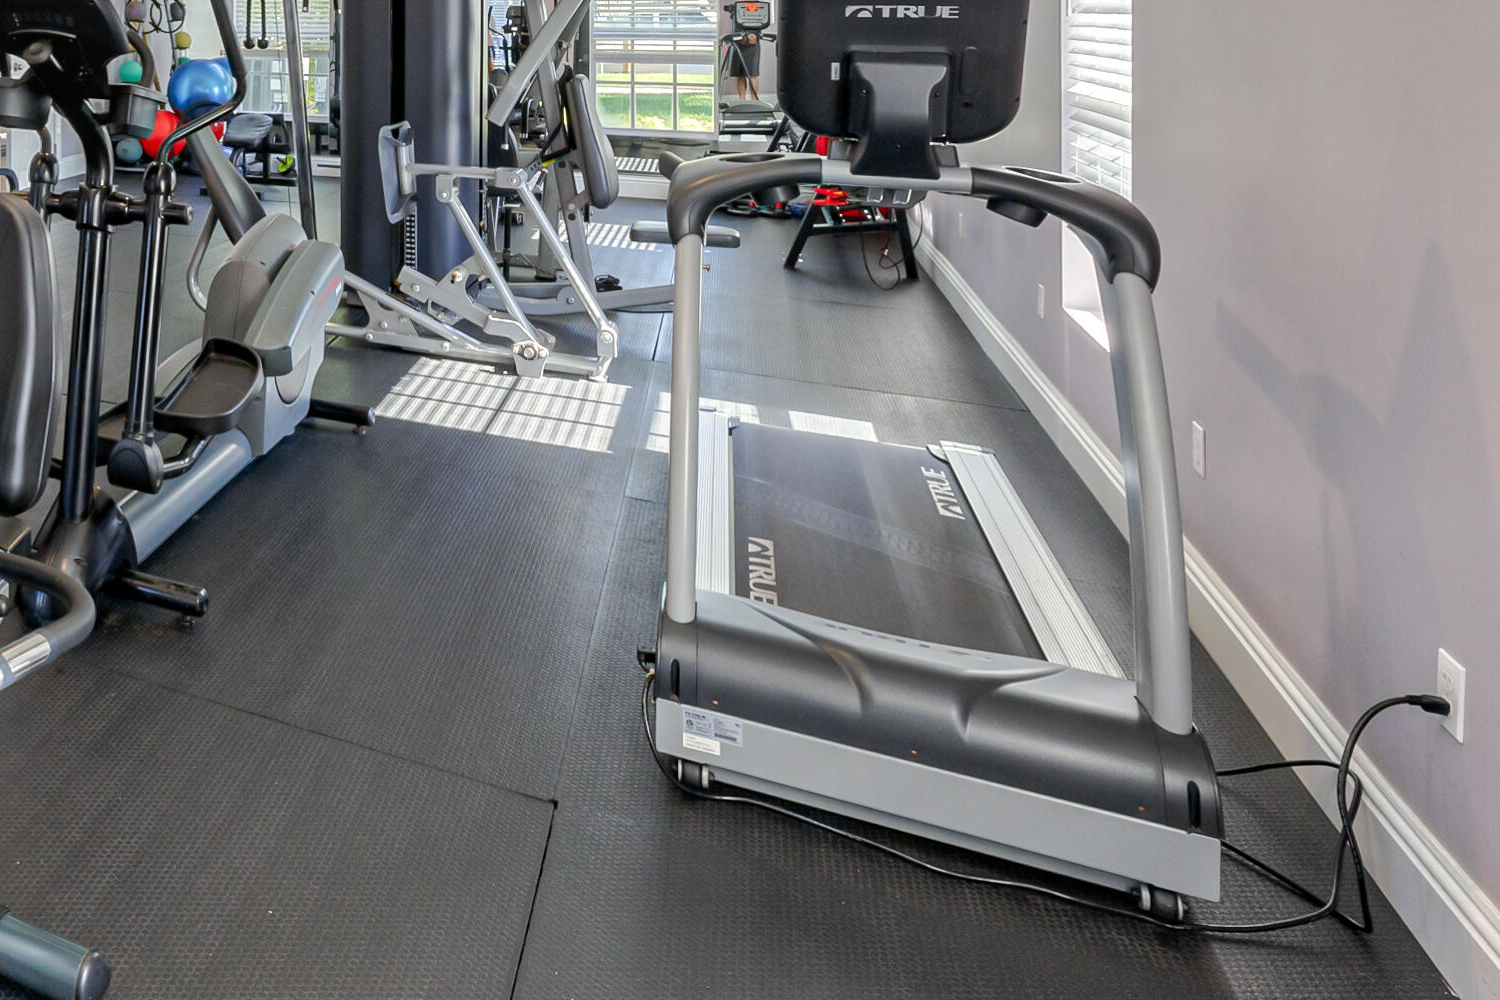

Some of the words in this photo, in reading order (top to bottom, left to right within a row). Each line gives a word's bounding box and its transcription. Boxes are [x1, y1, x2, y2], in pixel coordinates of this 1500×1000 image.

[875, 5, 960, 19] TRUE
[921, 466, 960, 507] TRUE
[748, 555, 778, 606] TRUE
